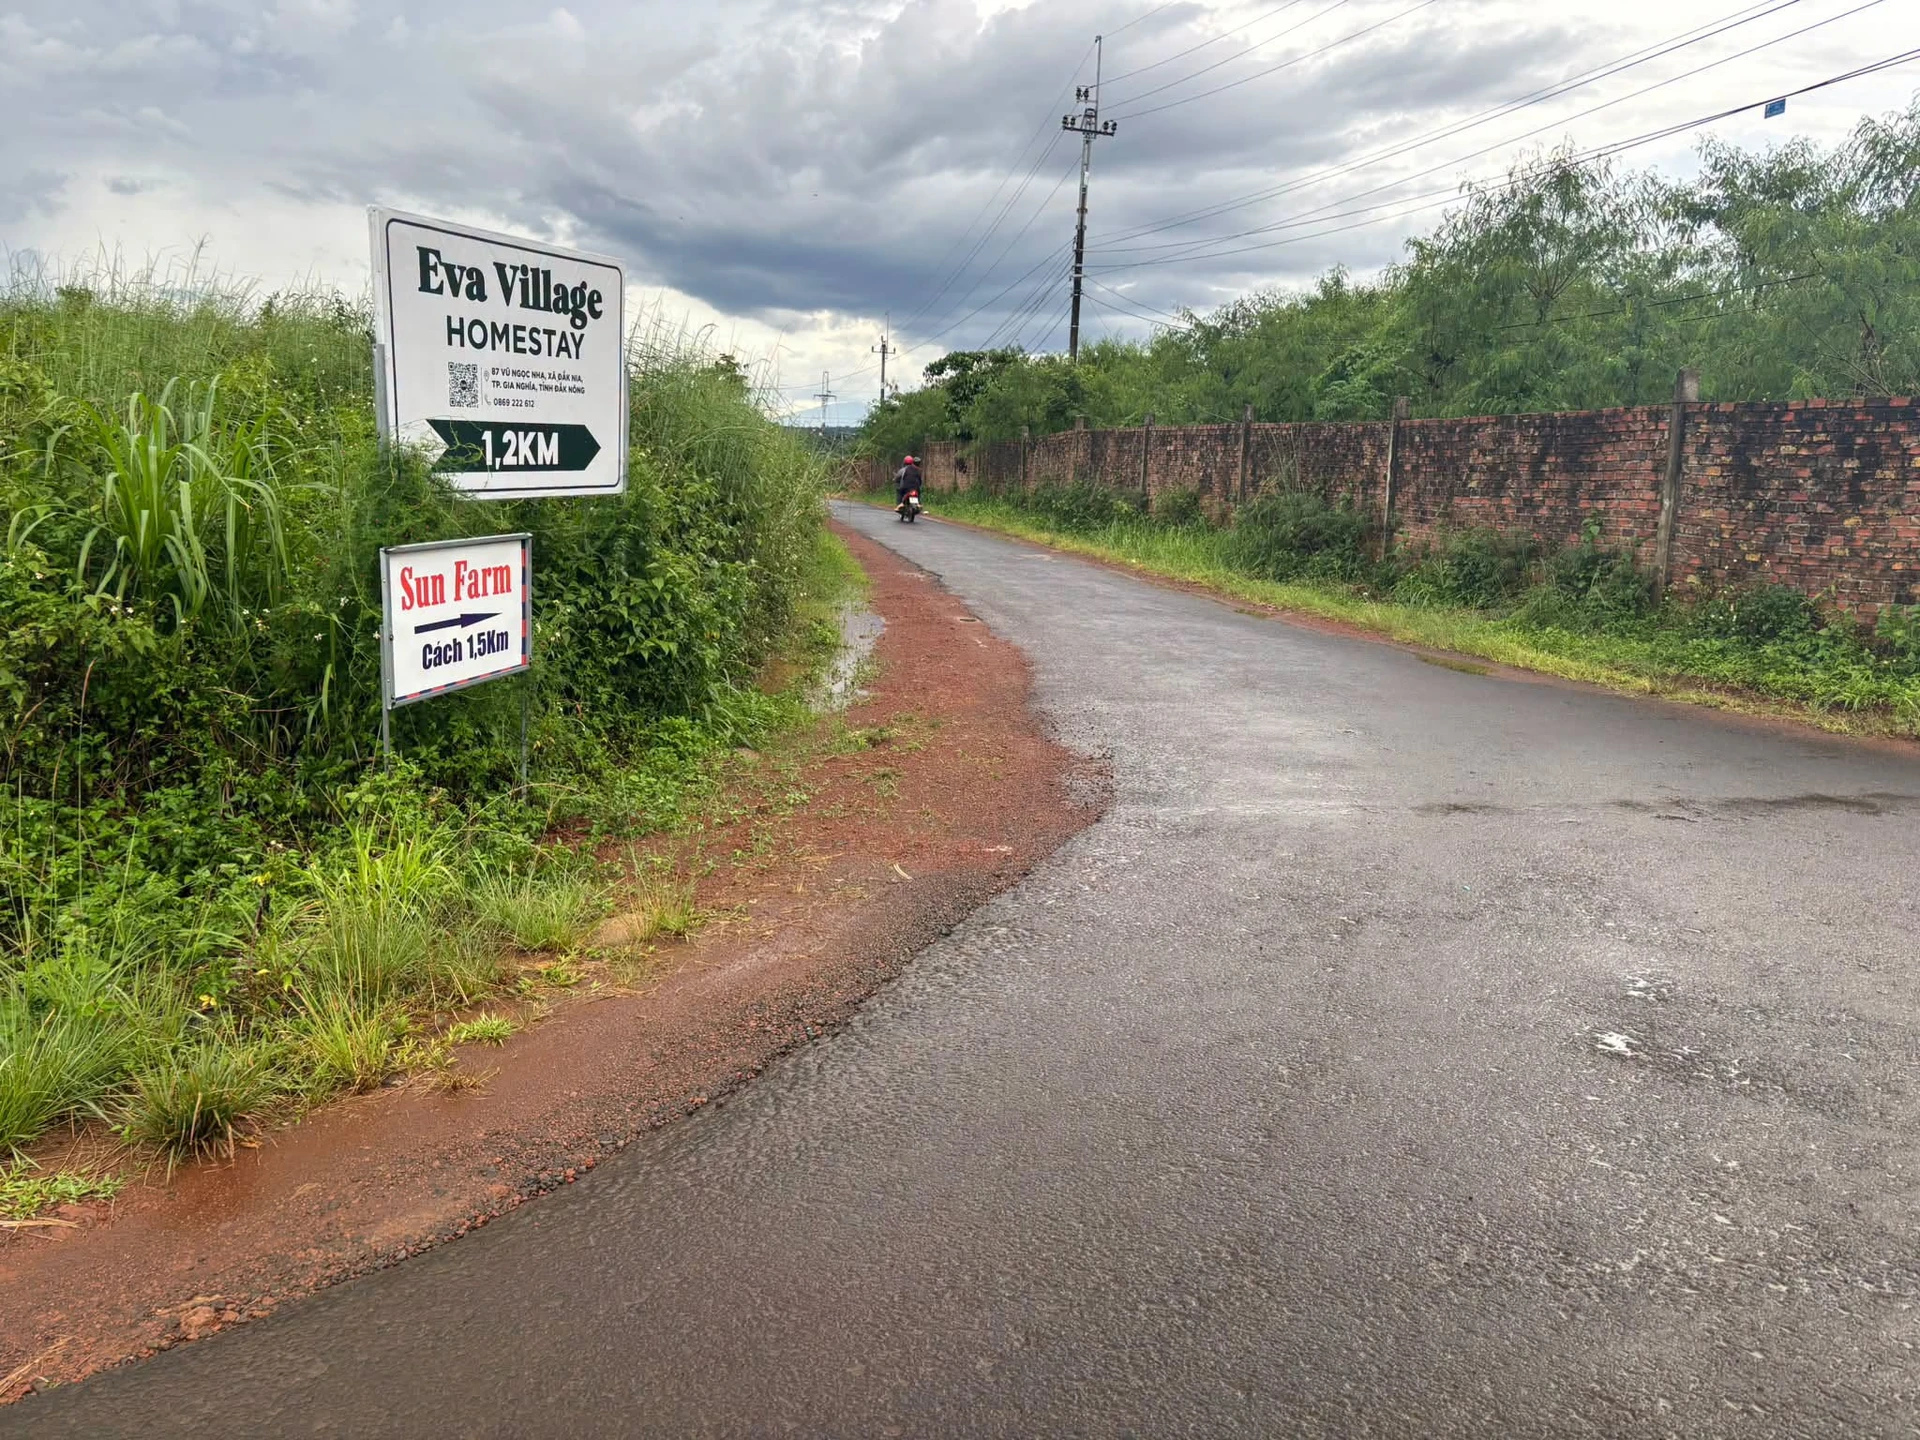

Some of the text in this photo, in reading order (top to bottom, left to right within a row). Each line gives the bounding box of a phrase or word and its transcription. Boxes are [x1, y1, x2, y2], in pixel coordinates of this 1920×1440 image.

[416, 246, 603, 329] Eva Village
[446, 315, 585, 359] HOMESTAY
[491, 367, 500, 376] 87
[491, 380, 502, 389] TP.
[503, 381, 515, 390] GIA
[511, 399, 523, 407] 222
[524, 399, 535, 408] 612
[481, 430, 559, 470] 1,2KM
[400, 560, 512, 611] Sun Farm
[422, 629, 509, 670] Cách 1,5Km
